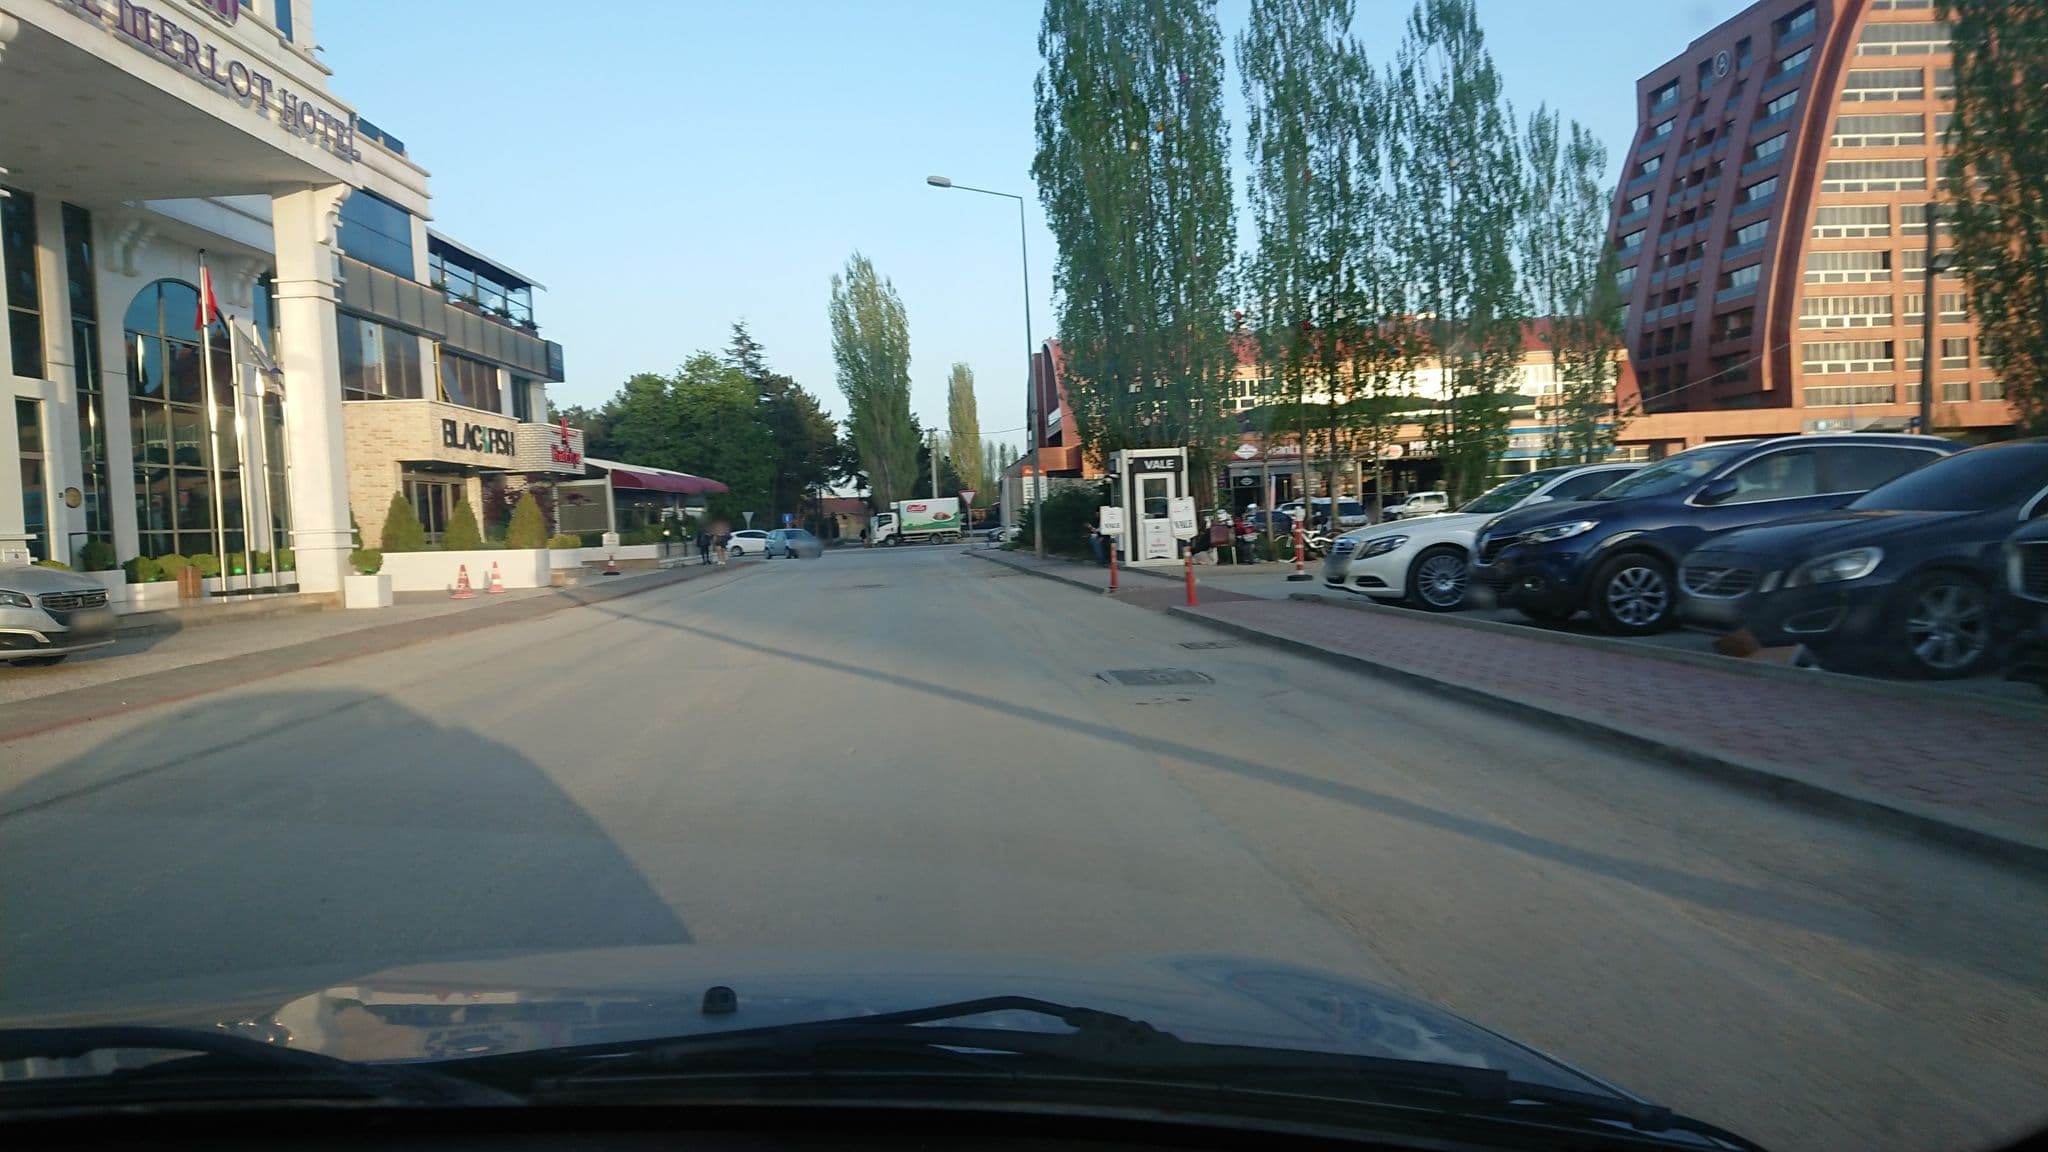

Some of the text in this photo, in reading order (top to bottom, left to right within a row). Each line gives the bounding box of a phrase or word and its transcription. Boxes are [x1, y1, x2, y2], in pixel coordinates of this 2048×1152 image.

[117, 0, 362, 162] MERLOT HOTEL
[1143, 459, 1175, 469] VALE
[1173, 519, 1193, 529] VALE
